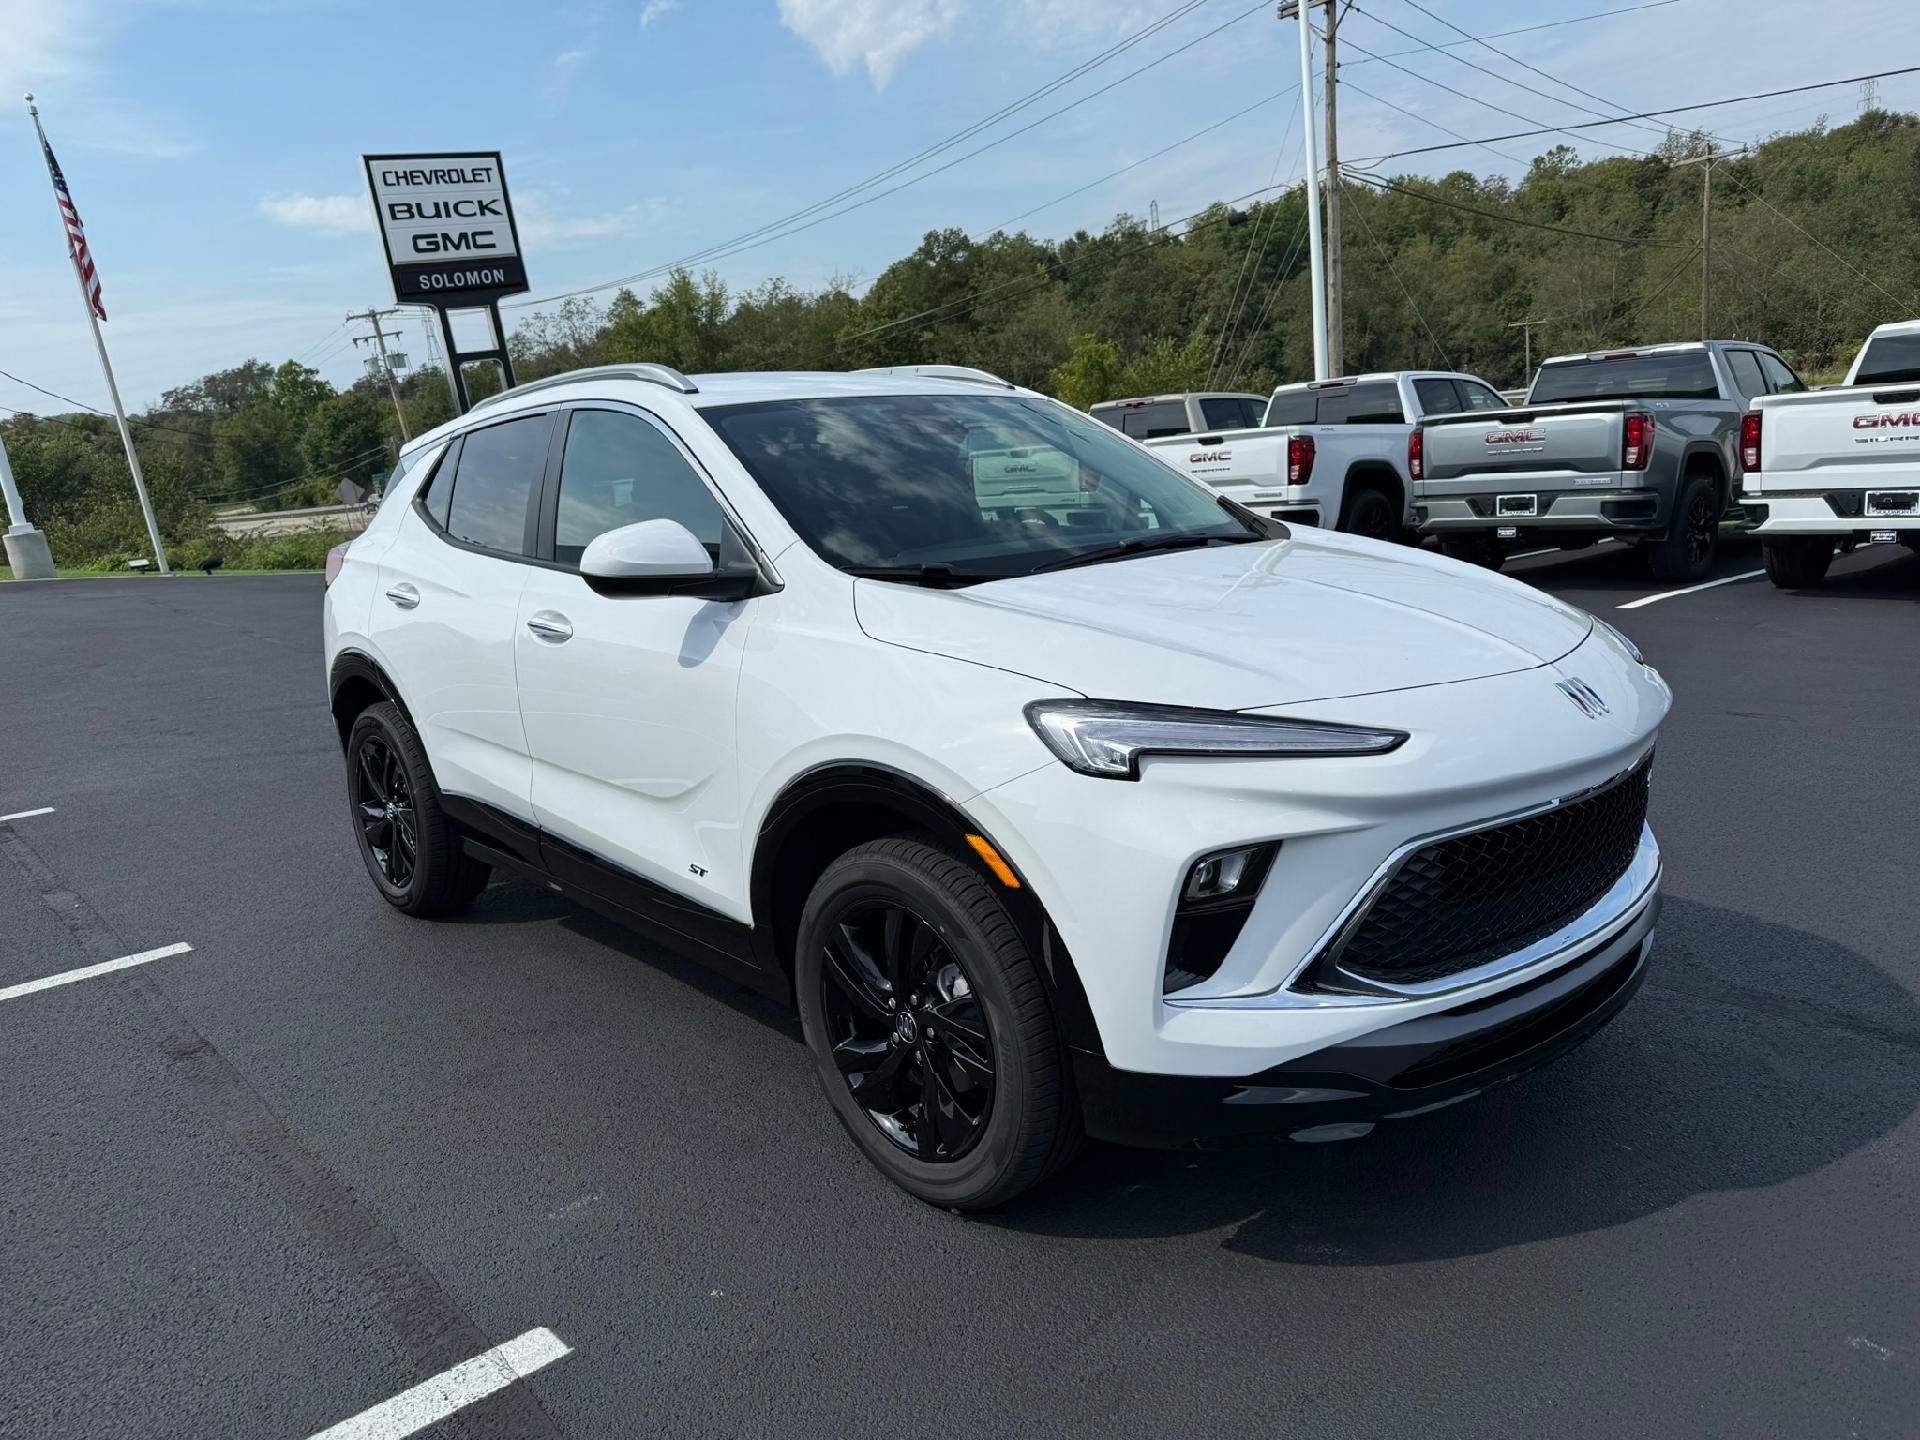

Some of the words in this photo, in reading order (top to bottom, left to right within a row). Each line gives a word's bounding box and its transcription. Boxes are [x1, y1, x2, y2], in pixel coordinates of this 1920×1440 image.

[382, 167, 492, 187] CHEVROLET
[387, 199, 503, 220] BUICK
[412, 230, 497, 253] GMC
[419, 268, 505, 290] SOLOMON
[1485, 428, 1546, 445] GMC
[1190, 451, 1232, 463] GMC
[688, 863, 709, 878] ST
